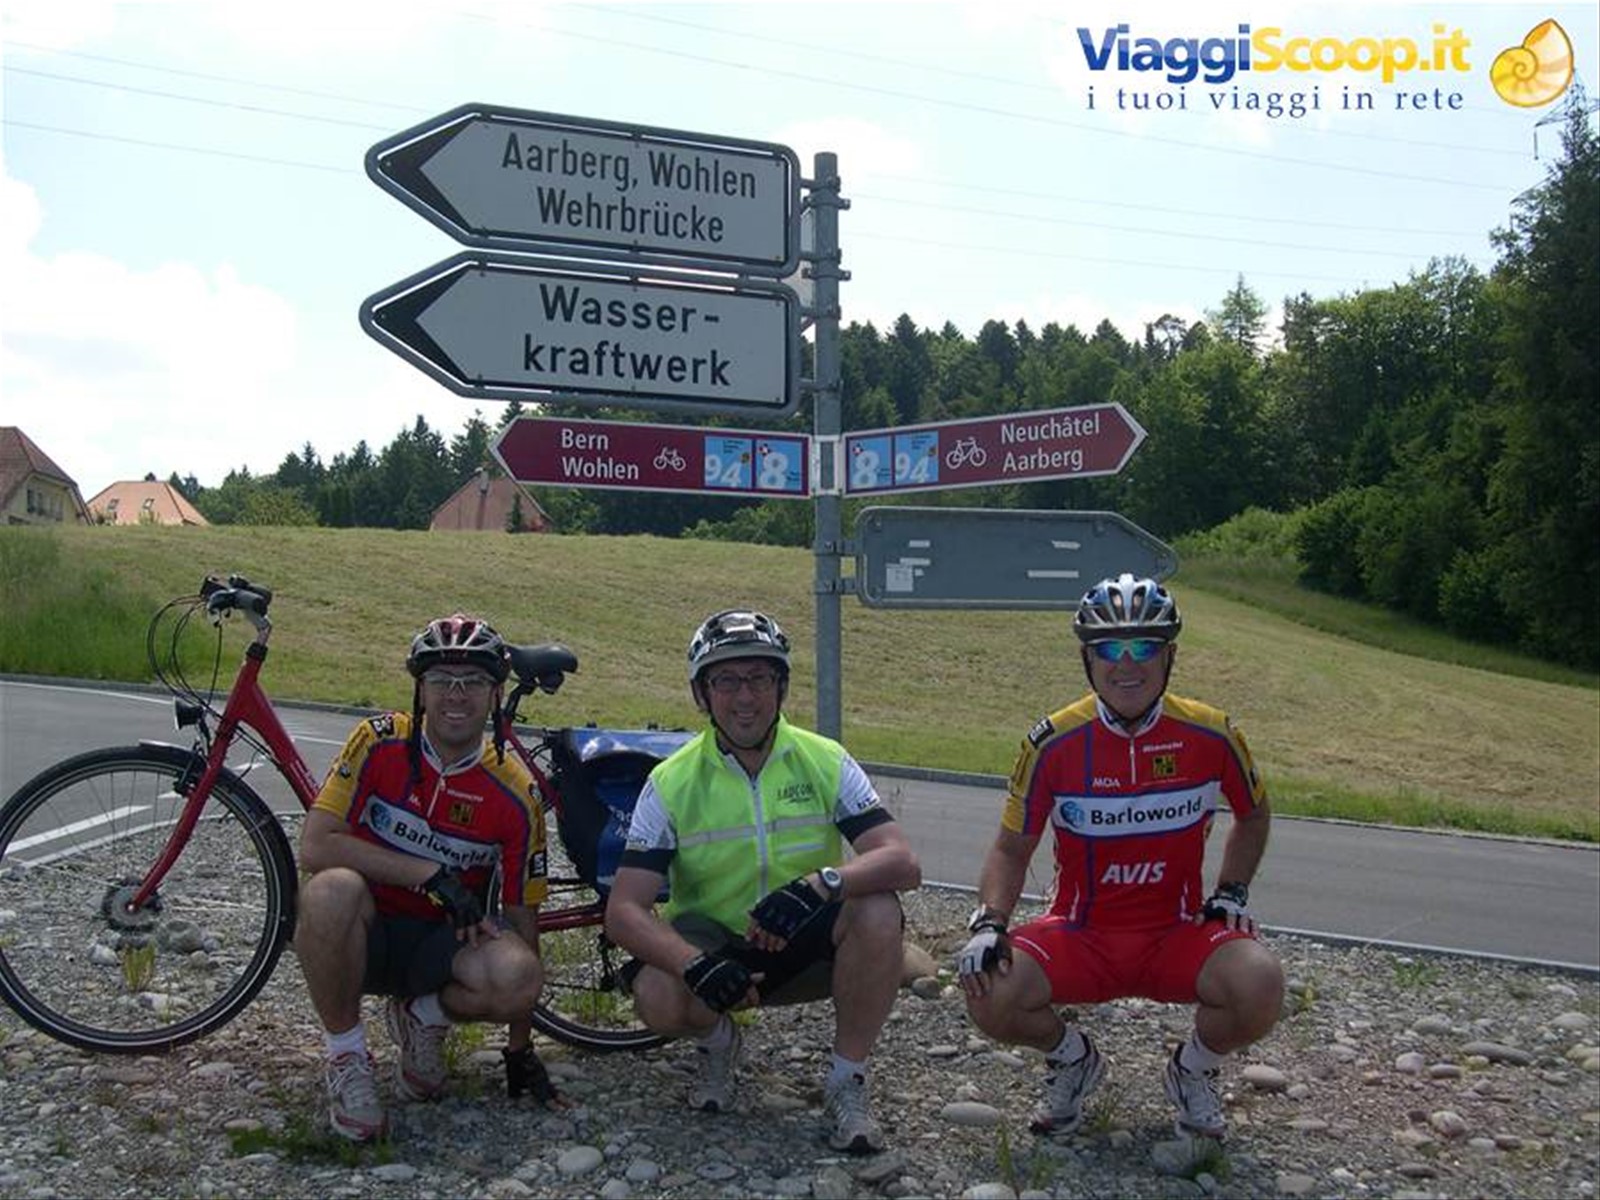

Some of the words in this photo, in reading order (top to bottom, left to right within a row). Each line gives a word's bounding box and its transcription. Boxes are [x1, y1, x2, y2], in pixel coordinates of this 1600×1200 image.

[501, 132, 640, 190] Aarberg,
[648, 150, 757, 200] Wohlen
[536, 186, 725, 244] Wehrbrücke
[539, 283, 721, 334] Wasser-
[523, 333, 732, 387] kraftwerk
[561, 428, 609, 451] Bern
[1001, 412, 1101, 445] Neuchâtel
[562, 457, 640, 481] Wohlen
[704, 454, 743, 487] 94
[759, 452, 789, 490] 8
[854, 451, 880, 489] 8
[895, 453, 931, 484] 94
[1002, 448, 1084, 473] Aarberg
[1090, 796, 1203, 826] Barloworld
[1100, 861, 1167, 885] AVIS
